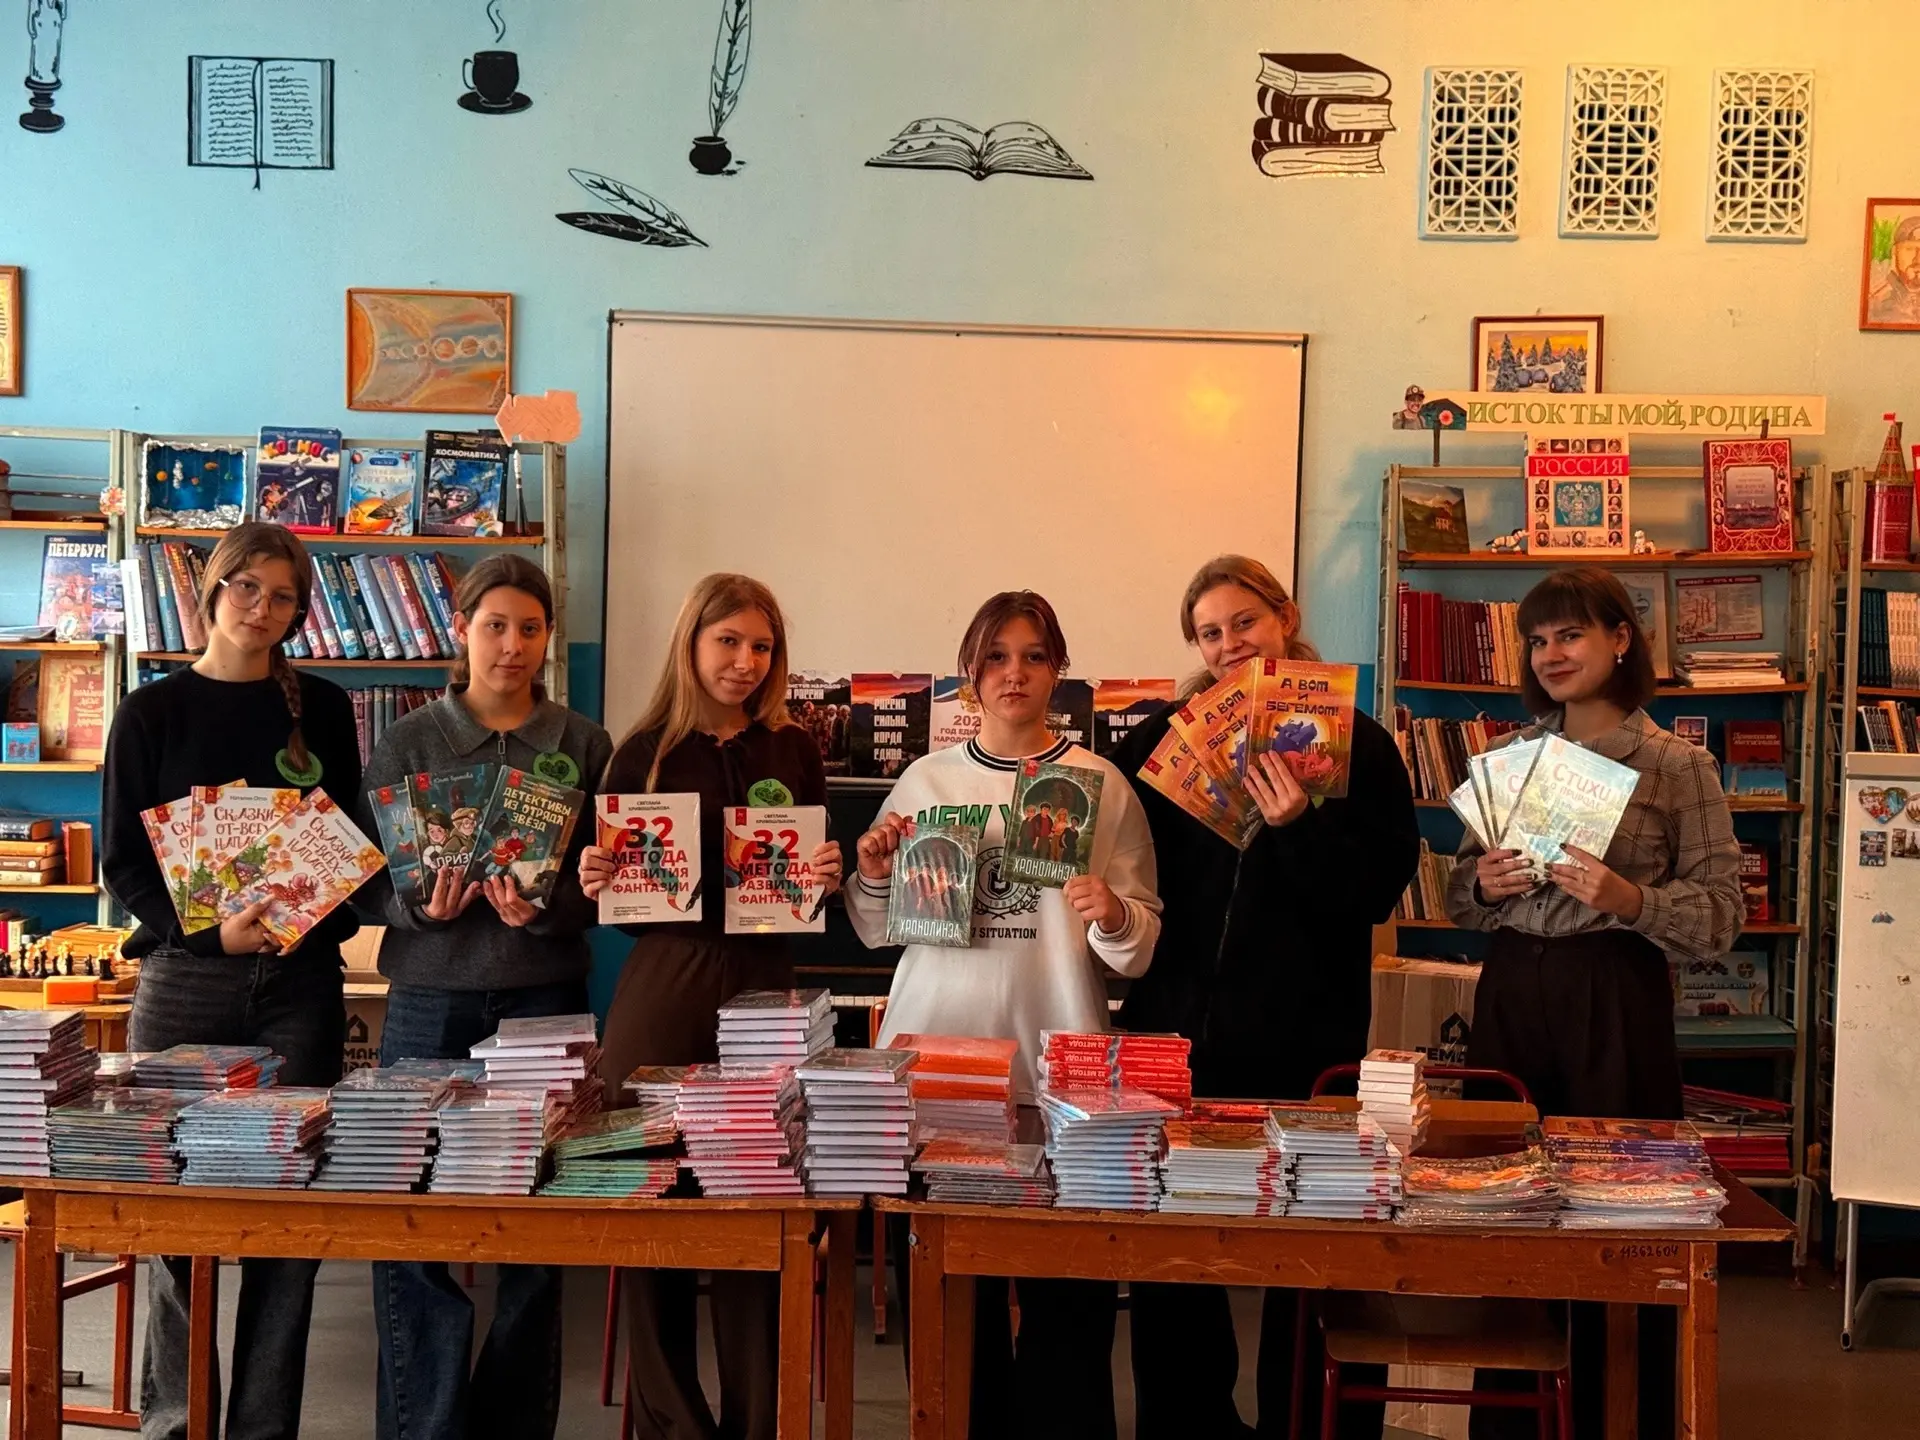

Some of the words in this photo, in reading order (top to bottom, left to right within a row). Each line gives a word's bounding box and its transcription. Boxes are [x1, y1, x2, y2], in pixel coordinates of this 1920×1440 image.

[1467, 401, 1565, 425] ИСТОК
[1570, 402, 1613, 426] ТЫ
[1689, 405, 1811, 431] РОДИНА
[263, 439, 332, 462] КОСМОС
[435, 448, 501, 460] КОСМОНАВТИКА
[1534, 457, 1623, 476] РОССИЯ
[48, 543, 108, 558] ПЕТЕРБУРГ
[1280, 678, 1292, 689] А
[1297, 692, 1308, 701] И
[953, 715, 982, 727] 202
[1206, 714, 1248, 750] БЕГЕМ
[503, 787, 572, 816] ДЕТЕКТИВЫ
[503, 798, 519, 811] ИЗ
[522, 804, 564, 826] ОТРЯДА
[625, 816, 674, 848] 32
[751, 829, 799, 860] 32
[612, 850, 688, 867] МЕТОДА
[612, 867, 689, 880] РАЗВИТИЯ
[738, 862, 812, 878] МЕТОДА
[1013, 857, 1076, 879] ХРОНОЛИНЗА
[612, 882, 689, 893] ФАНТАЗИИ
[738, 879, 813, 891] РАЗВИТИЯ
[738, 894, 813, 904] ФАНТАЗИИ
[900, 919, 960, 938] ХРОНОЛИНЗА
[979, 927, 1037, 939] SITUATION
